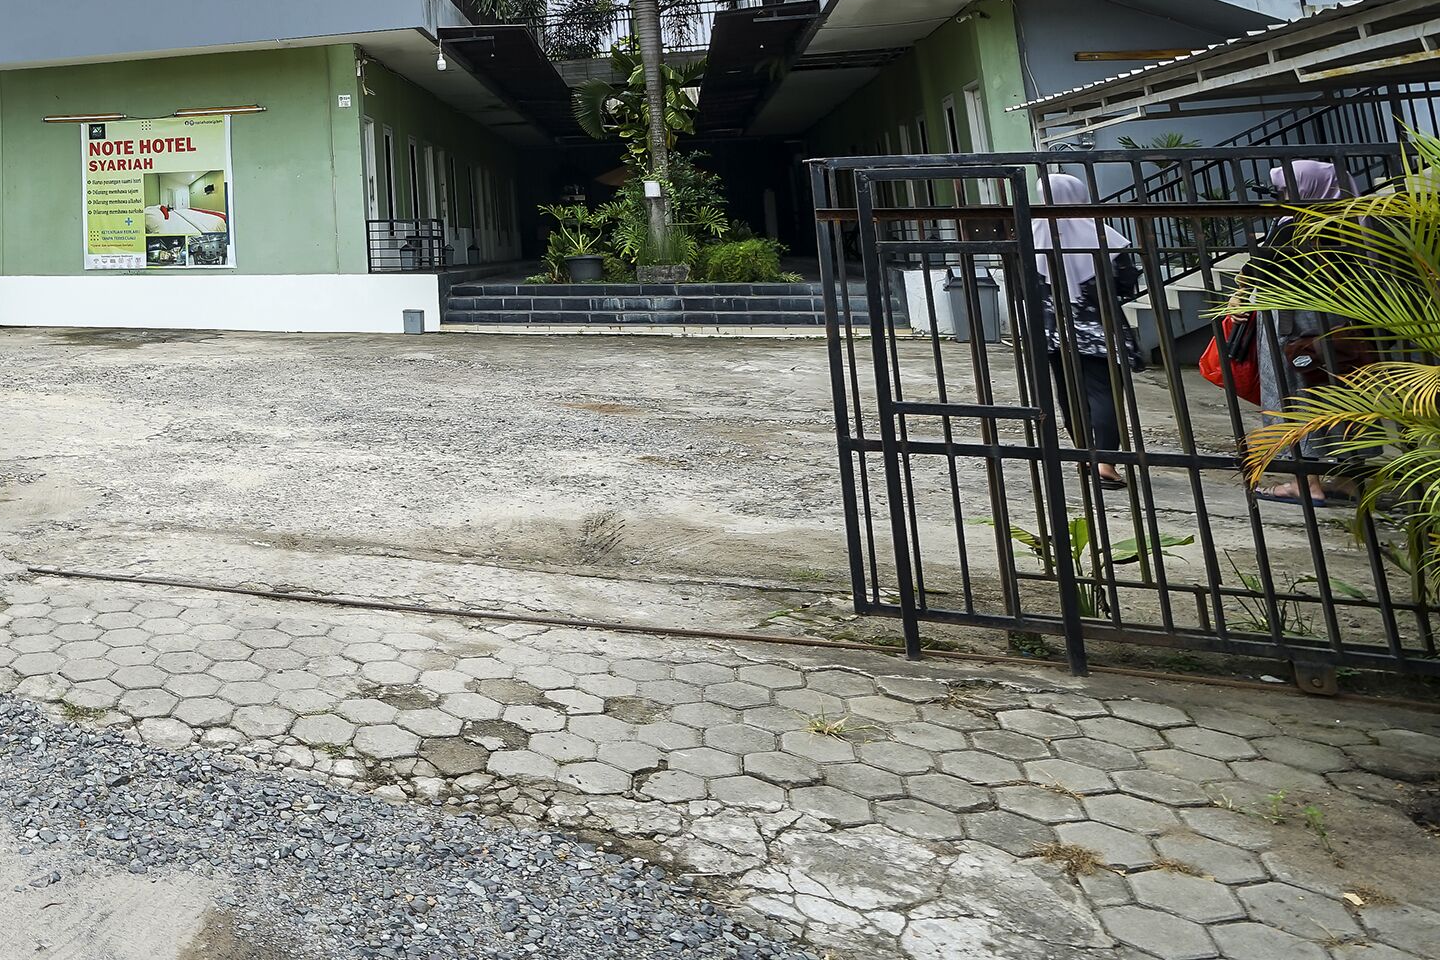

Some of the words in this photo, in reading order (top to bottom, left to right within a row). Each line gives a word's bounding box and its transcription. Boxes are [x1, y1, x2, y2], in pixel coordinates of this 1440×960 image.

[89, 140, 134, 157] NOTE
[139, 137, 197, 154] HOTEL
[89, 158, 153, 172] SYARIAH
